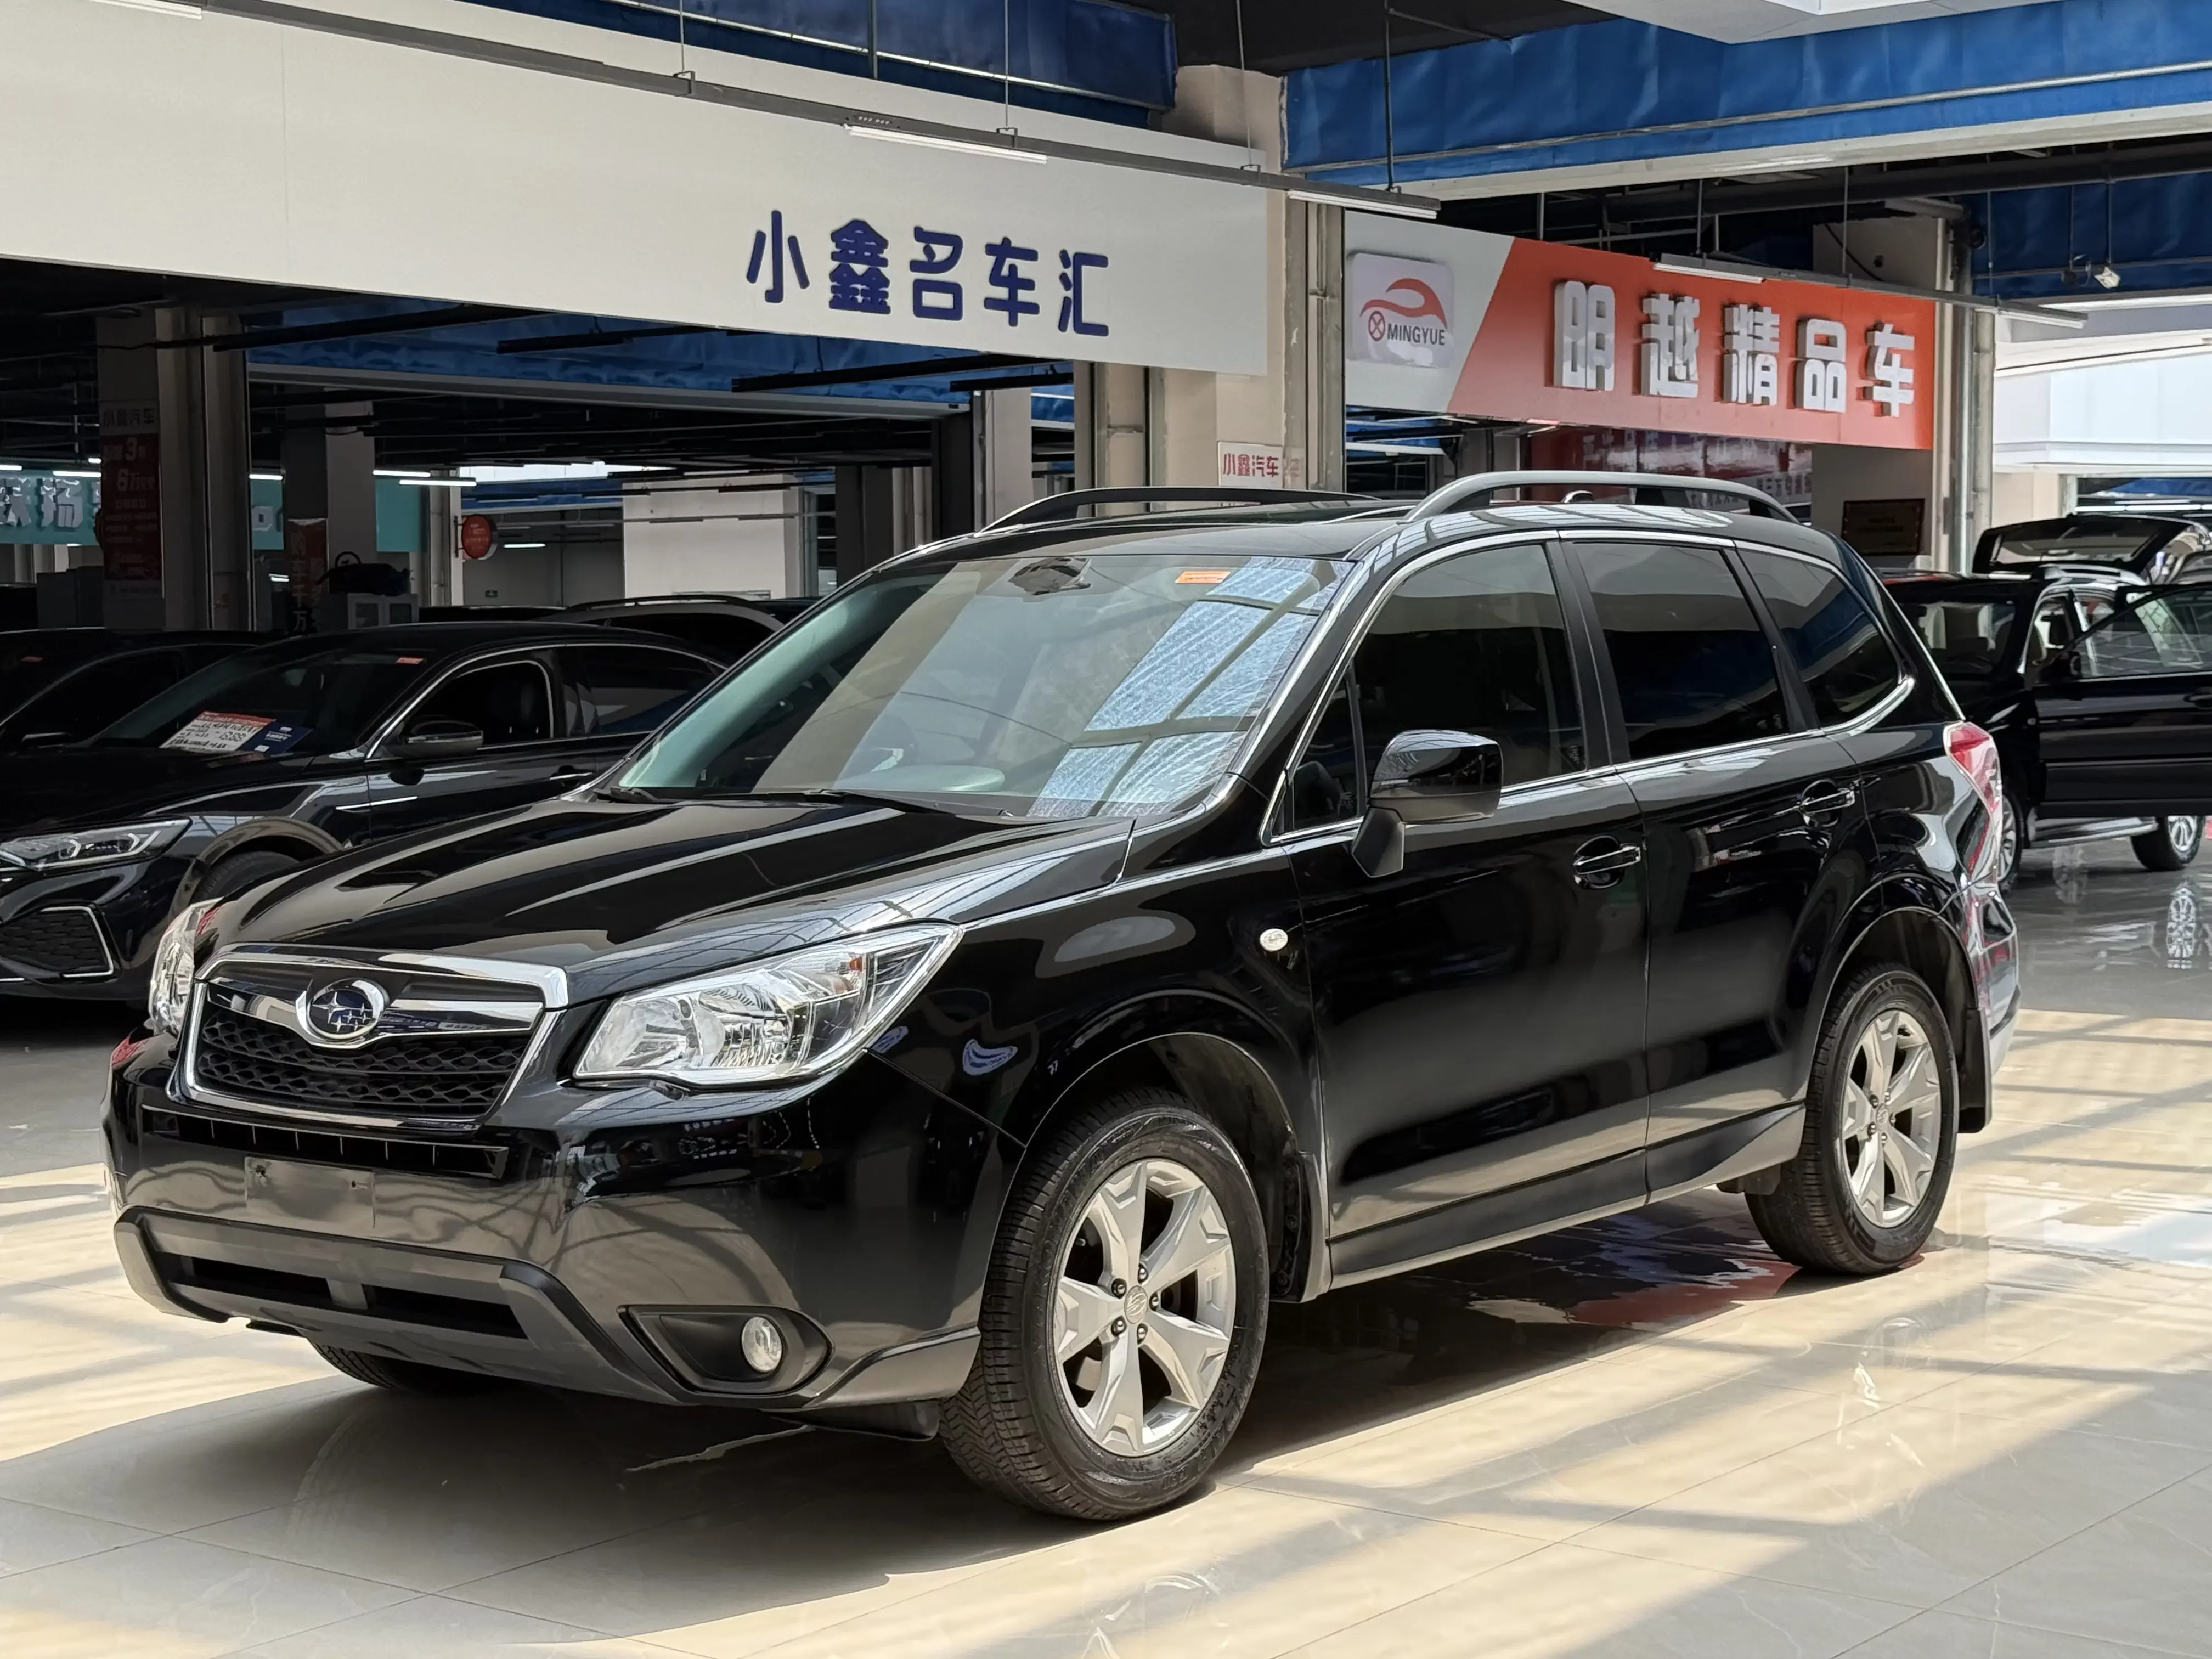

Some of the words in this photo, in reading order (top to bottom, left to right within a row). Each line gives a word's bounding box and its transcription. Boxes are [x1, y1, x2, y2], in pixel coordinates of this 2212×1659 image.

[746, 209, 1109, 337] 小鑫名车汇
[1386, 323, 1446, 346] MINGYUE
[1554, 280, 1915, 417] 明越精品车
[1222, 453, 1279, 478] 小鑫汽车
